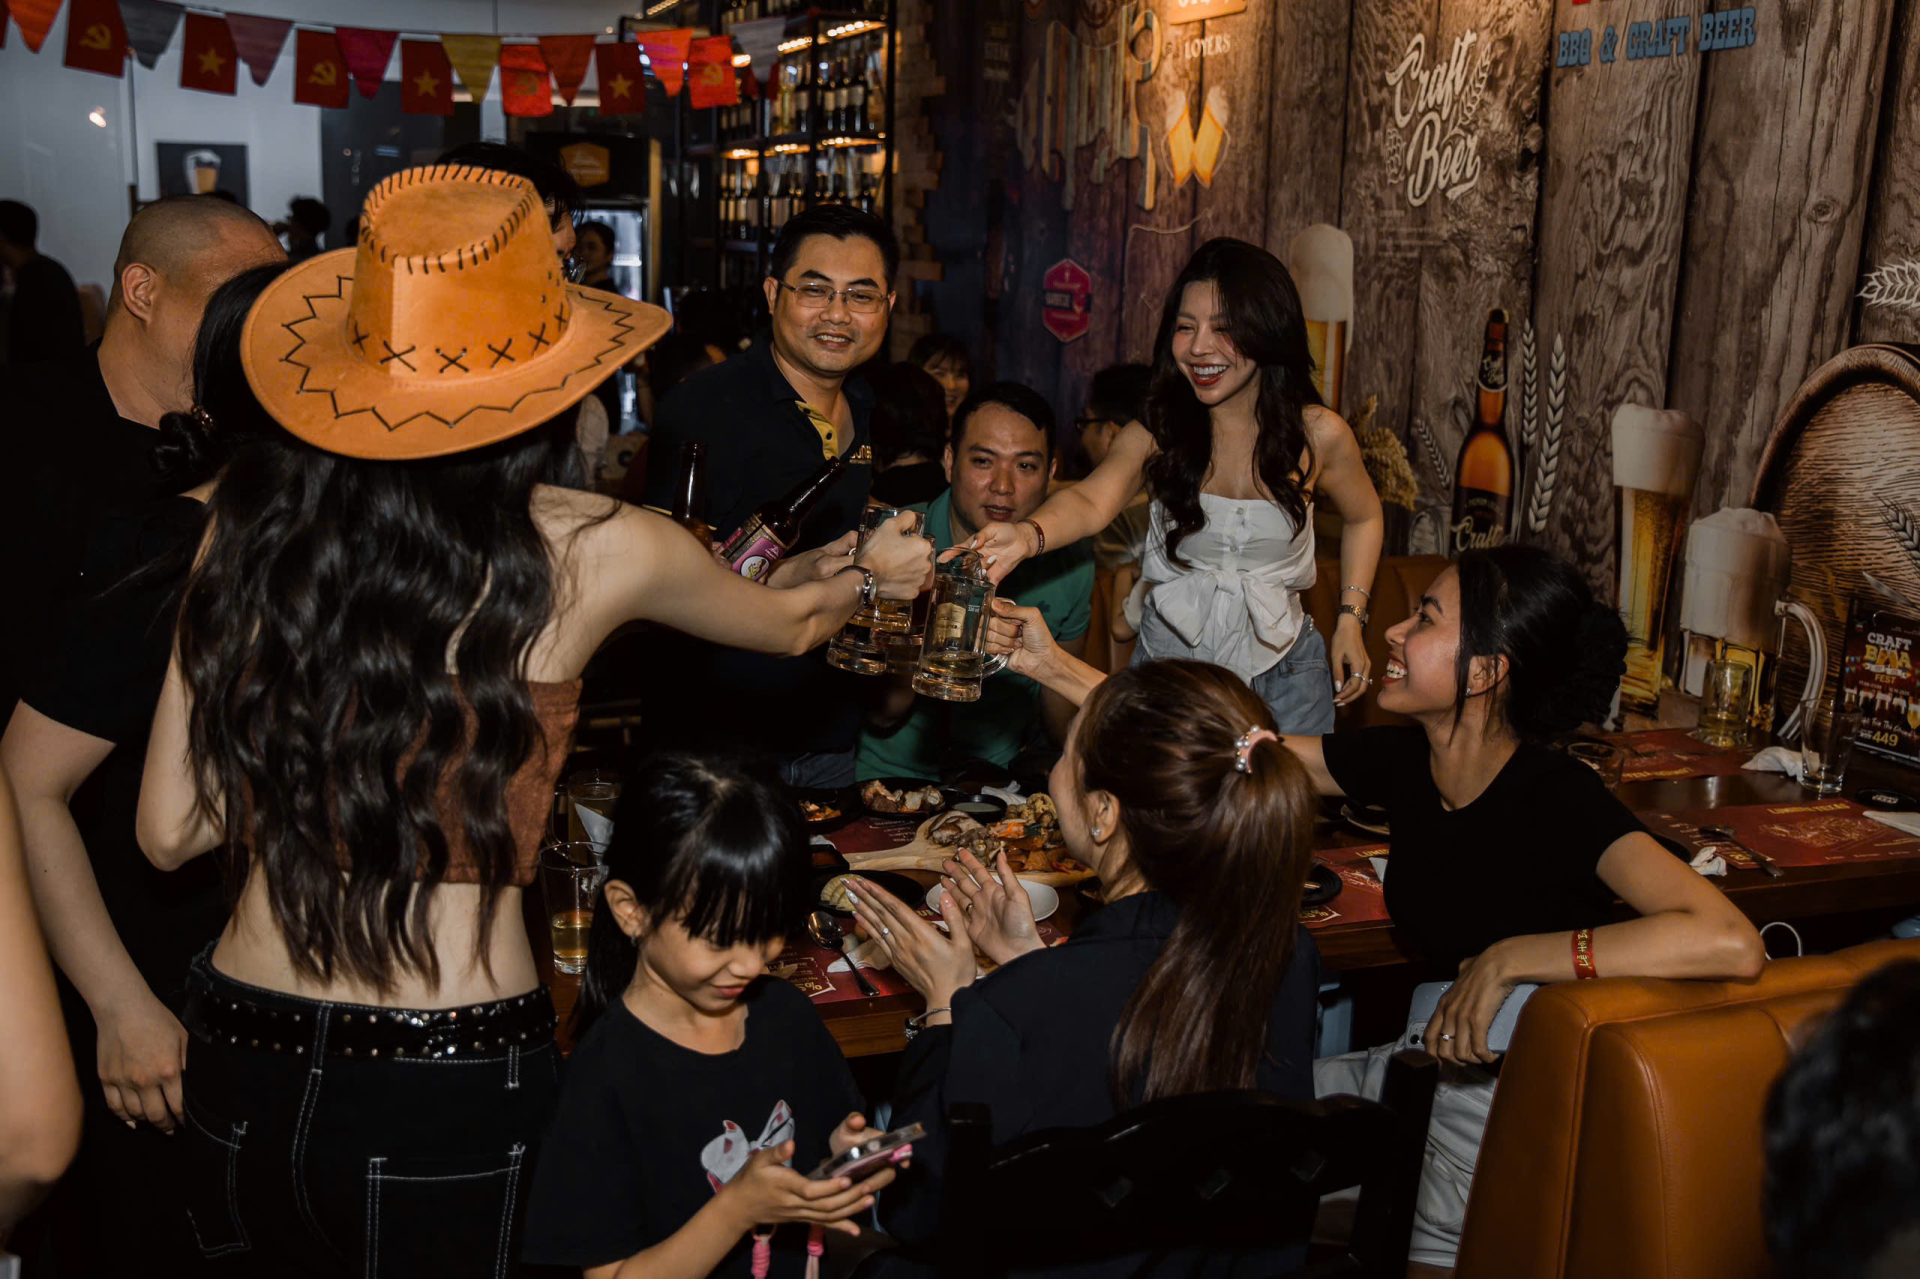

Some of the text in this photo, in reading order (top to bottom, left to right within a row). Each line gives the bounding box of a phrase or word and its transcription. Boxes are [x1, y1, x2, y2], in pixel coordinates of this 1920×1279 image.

[1557, 7, 1756, 67] BBQ & CRAFT BEER
[1385, 29, 1477, 128] Craft
[1406, 111, 1481, 207] Beer
[1867, 631, 1913, 651] CRAFT
[1874, 673, 1897, 685] FEST
[1872, 731, 1899, 747] 449
